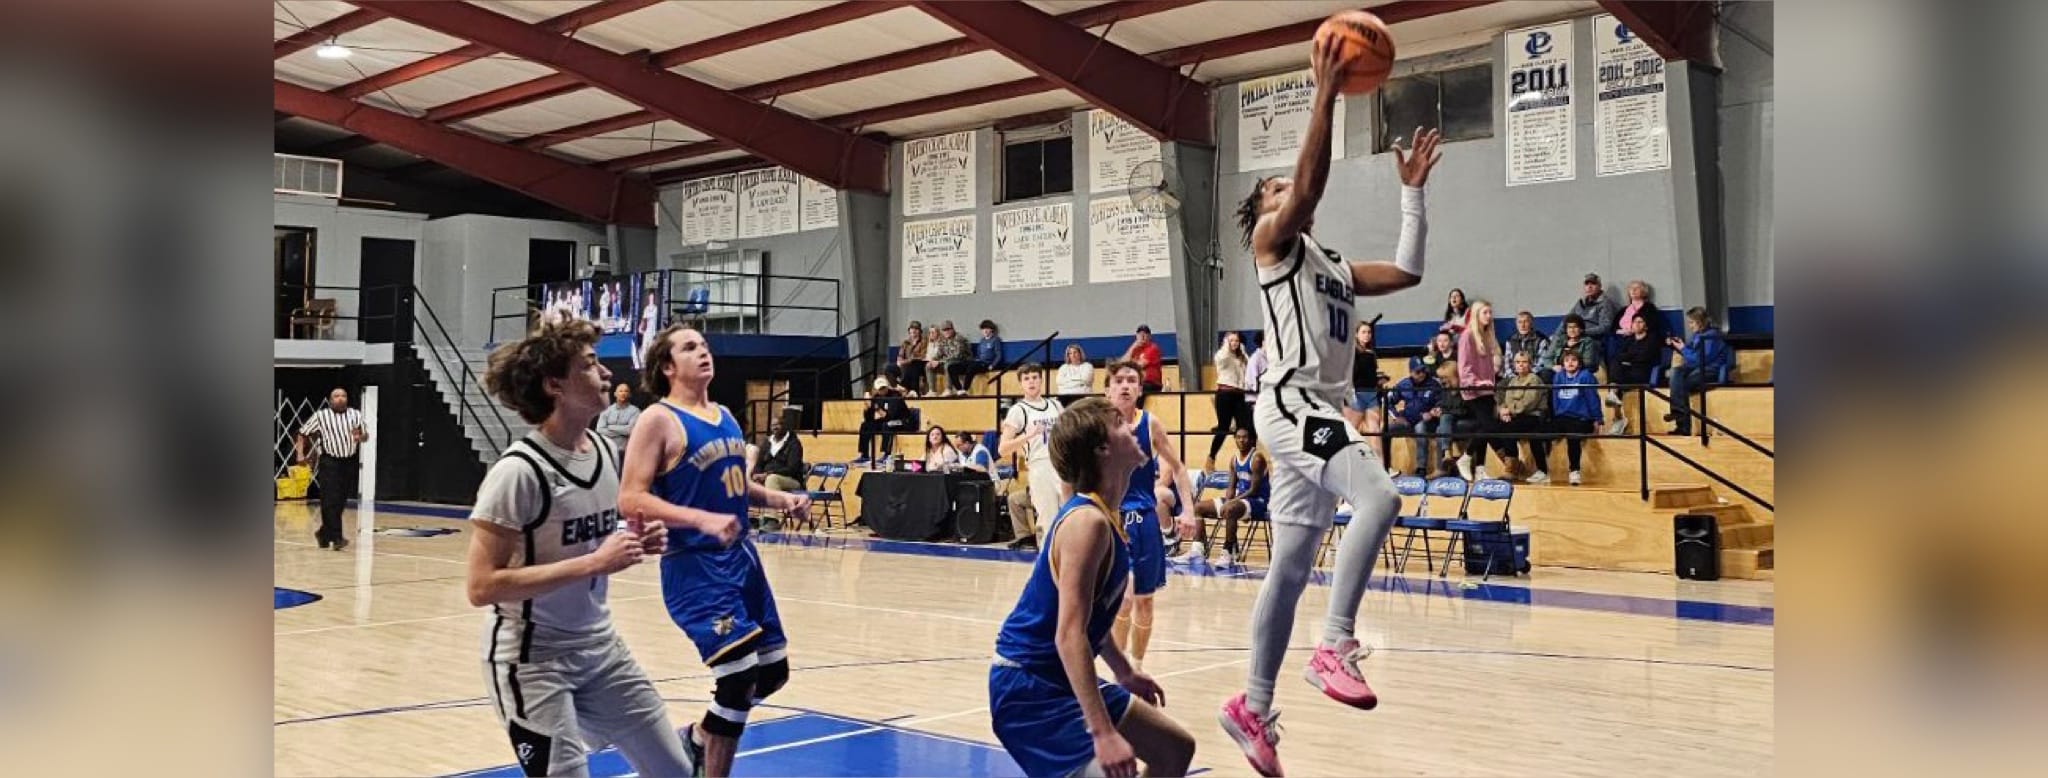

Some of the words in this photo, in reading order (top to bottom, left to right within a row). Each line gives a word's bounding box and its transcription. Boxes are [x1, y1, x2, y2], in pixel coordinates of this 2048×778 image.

[1511, 64, 1568, 94] 2011
[1327, 303, 1349, 343] 10
[721, 464, 744, 499] 10
